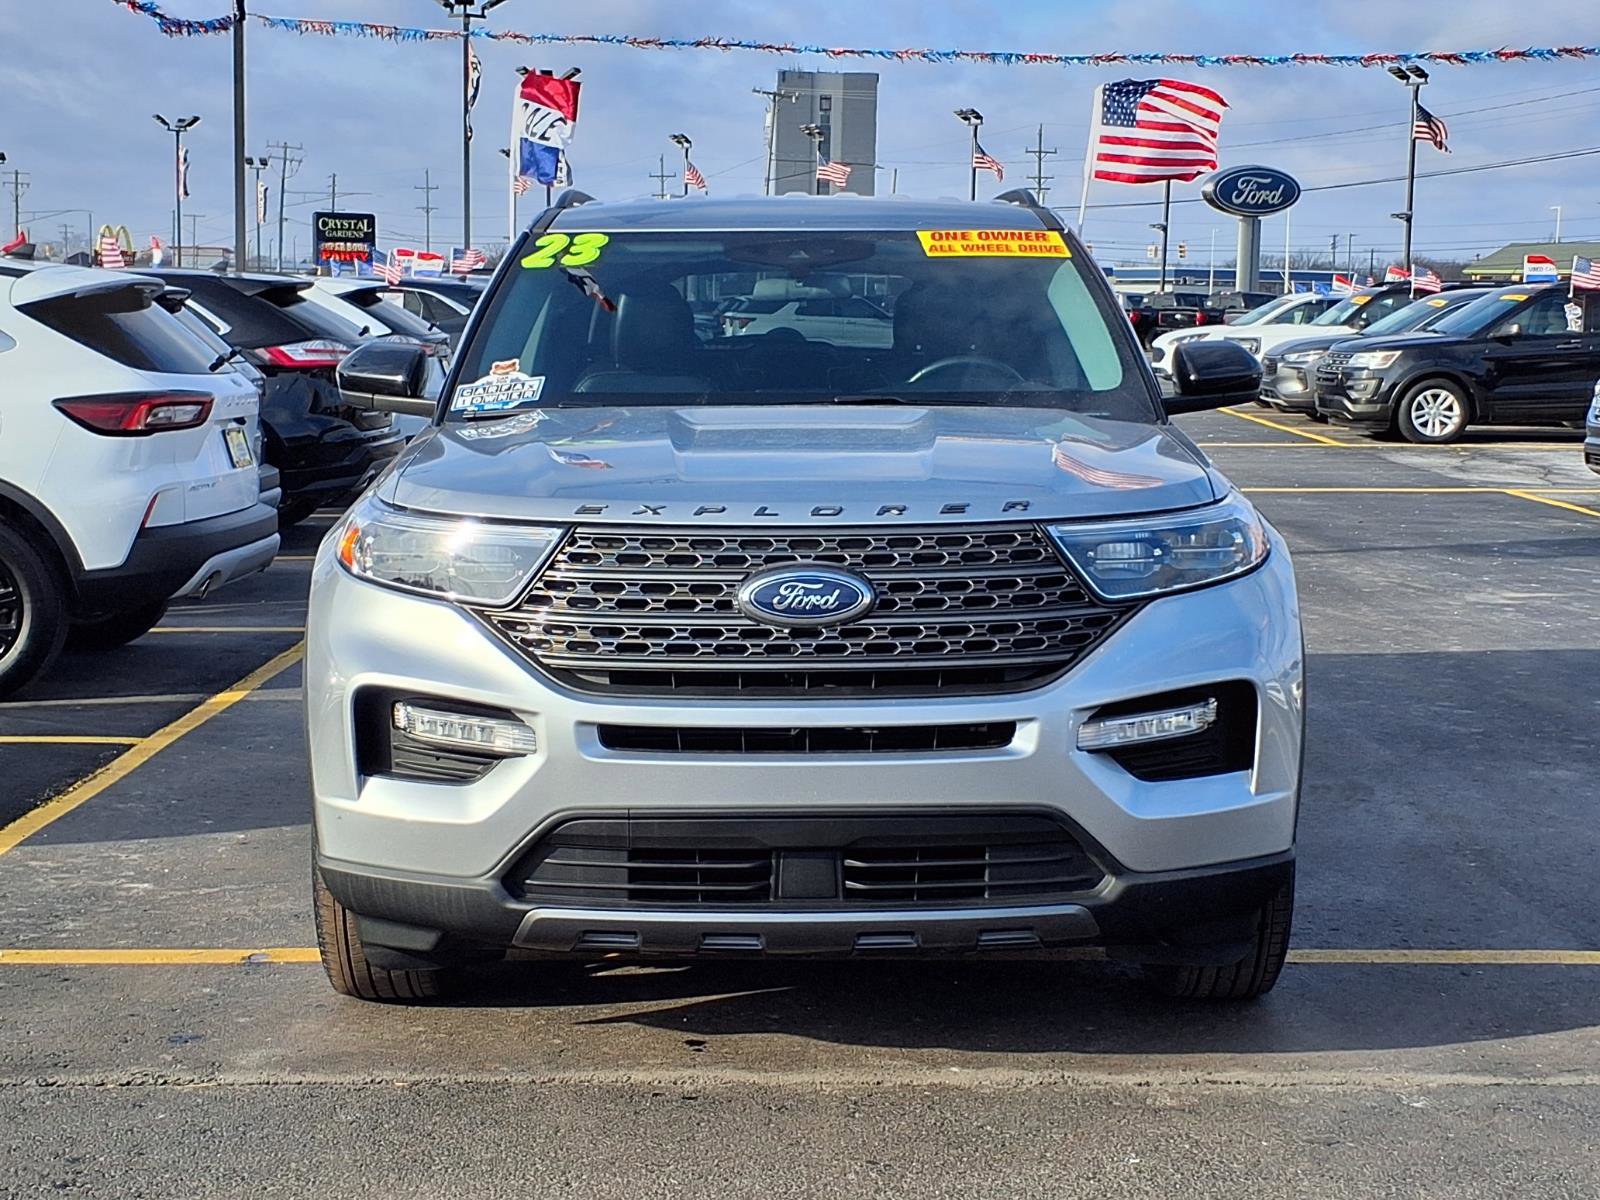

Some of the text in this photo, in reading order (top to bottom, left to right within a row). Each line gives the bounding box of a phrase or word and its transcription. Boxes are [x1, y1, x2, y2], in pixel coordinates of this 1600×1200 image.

[1231, 176, 1285, 205] Ford
[318, 217, 373, 232] CRYSTAL
[325, 230, 364, 238] GARDENS
[930, 231, 1049, 242] ONE OWNER
[521, 233, 609, 268] 23
[929, 243, 1066, 254] ALL WHEEL DRIVE
[460, 382, 536, 397] CARFAX
[574, 500, 1033, 517] EXPLORER
[772, 581, 841, 610] Ford
